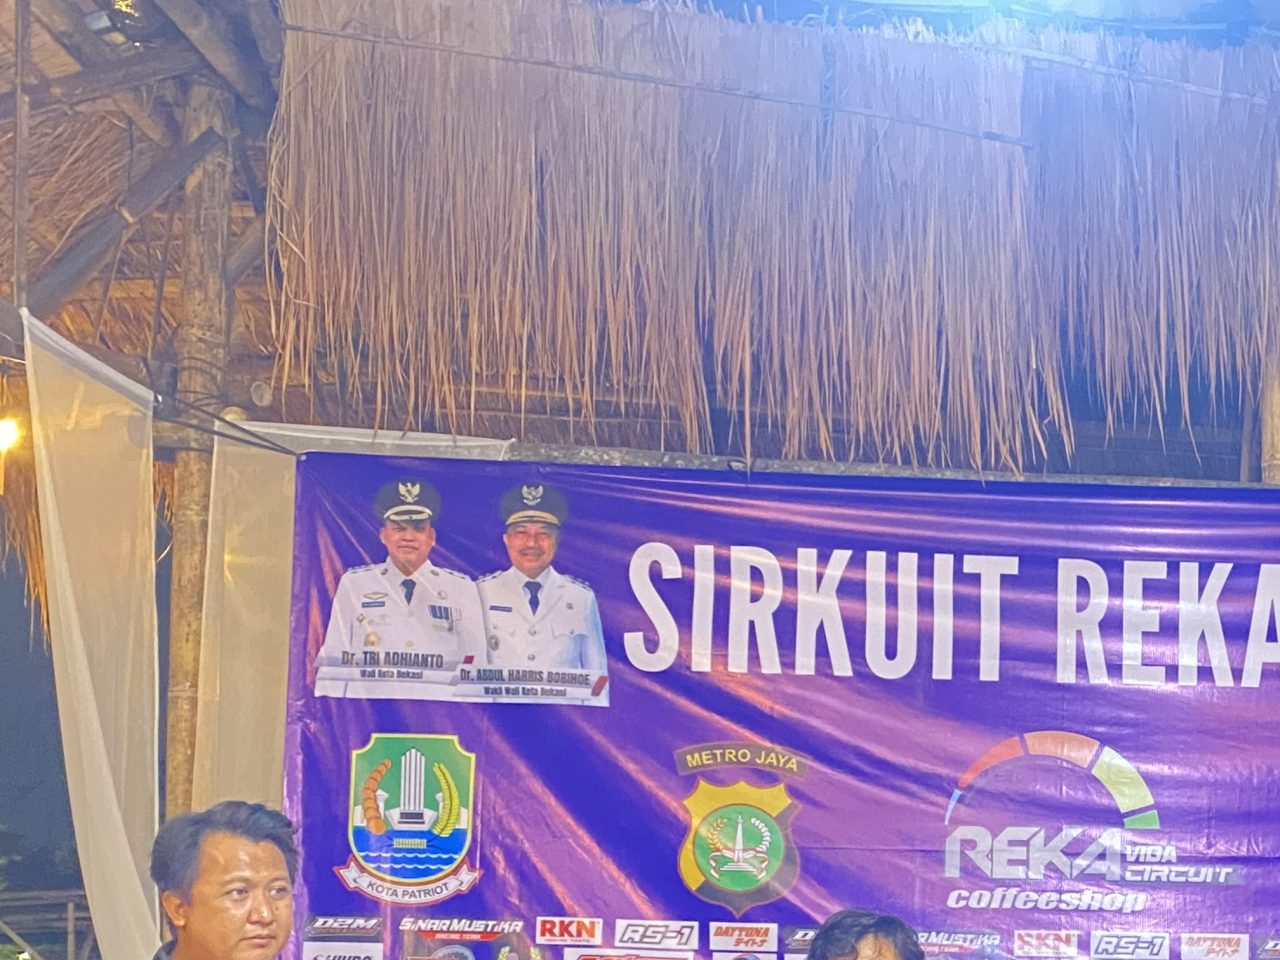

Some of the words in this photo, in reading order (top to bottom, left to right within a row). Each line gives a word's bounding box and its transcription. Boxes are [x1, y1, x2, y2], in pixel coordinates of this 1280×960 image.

[624, 541, 1020, 683] SIRKUIT
[363, 652, 380, 667] TRI
[383, 652, 444, 669] ADHIANTO
[476, 669, 505, 682] ABDUL
[508, 670, 544, 683] HARRIS
[686, 748, 751, 768] METRO
[755, 751, 798, 772] JAYA
[944, 825, 1125, 881] REKA
[366, 880, 399, 899] KOTA
[401, 881, 451, 900] PATRIOT
[945, 887, 1149, 914] coffeeshop
[313, 917, 379, 928] D2M
[539, 919, 597, 939] RKN
[713, 926, 769, 938] DAYTONA
[619, 924, 696, 945] RS-1
[1095, 935, 1165, 955] RS-1
